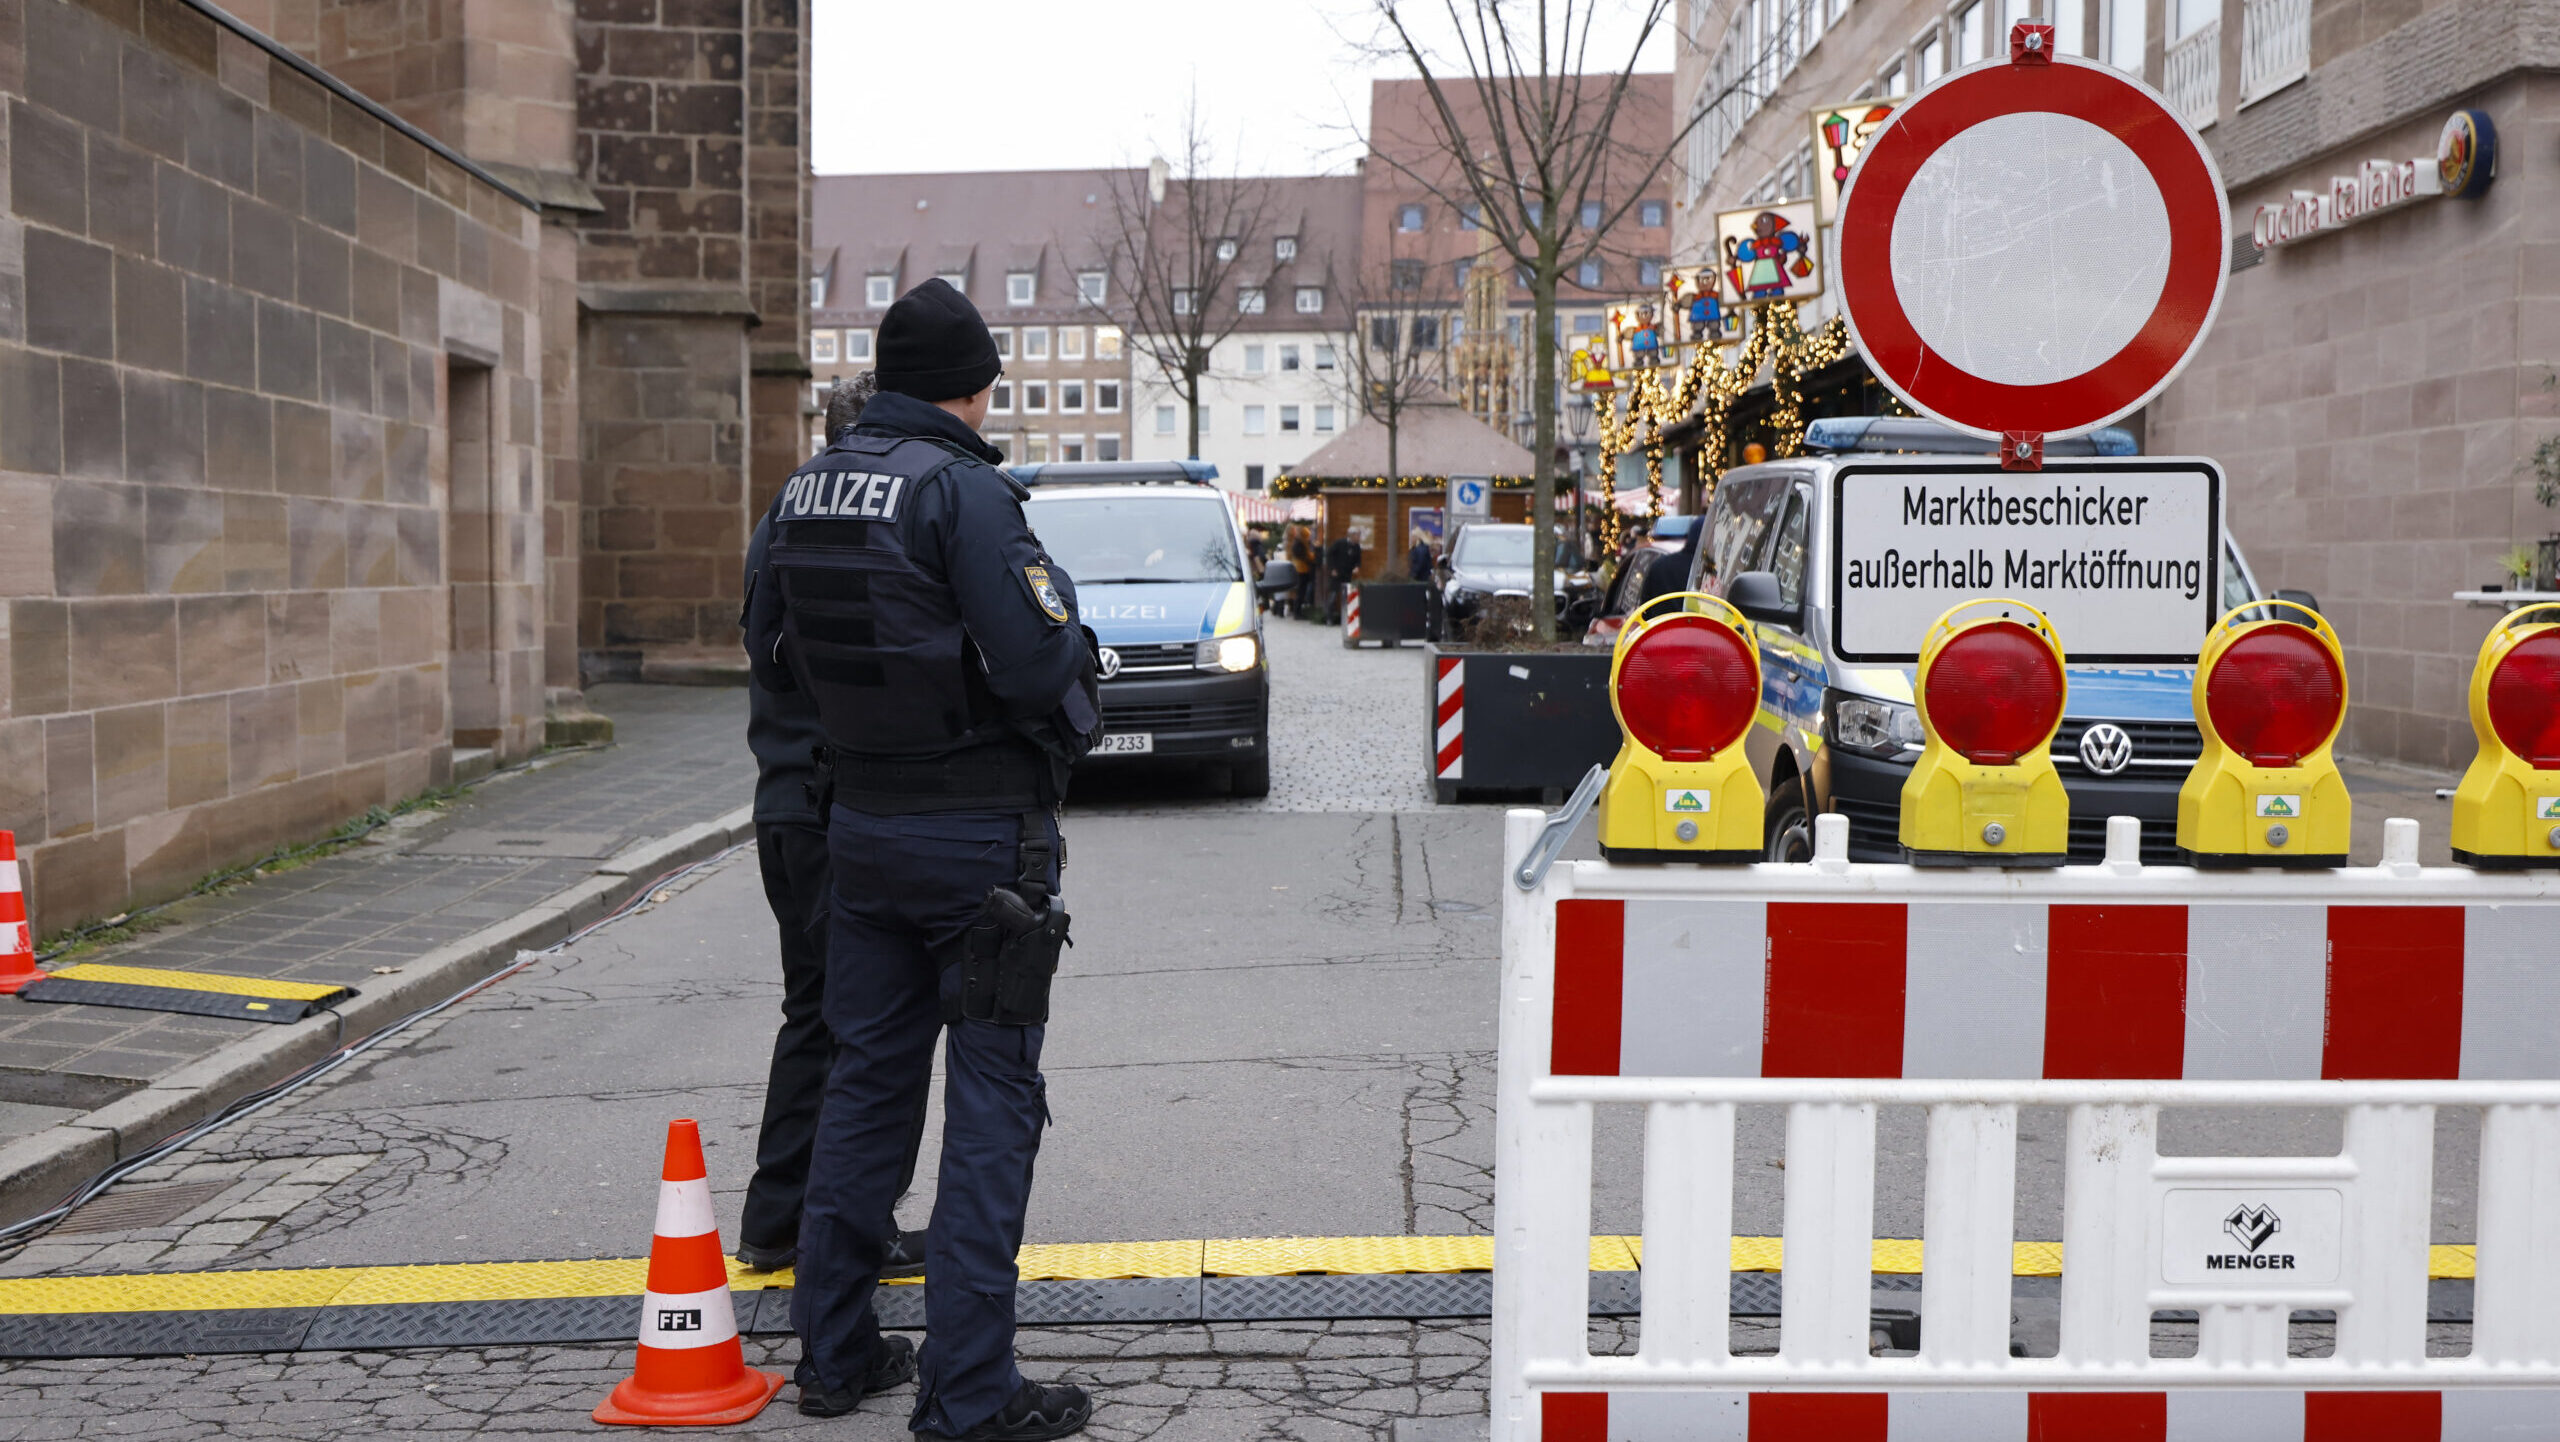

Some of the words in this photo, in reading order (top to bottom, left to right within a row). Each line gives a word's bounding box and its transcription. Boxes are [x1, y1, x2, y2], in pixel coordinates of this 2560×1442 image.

[2252, 192, 2319, 247] Cucina
[2328, 160, 2416, 223] Italiana
[780, 472, 904, 518] POLIZEI
[1902, 486, 2149, 526] Marktbeschicker
[1847, 548, 1994, 589] außerhalb
[2004, 548, 2201, 600] Marktöffnung
[1079, 605, 1166, 619] OLIZEI
[1116, 736, 1140, 751] 233
[2206, 1254, 2296, 1270] MENGER
[659, 1312, 699, 1330] FFL
